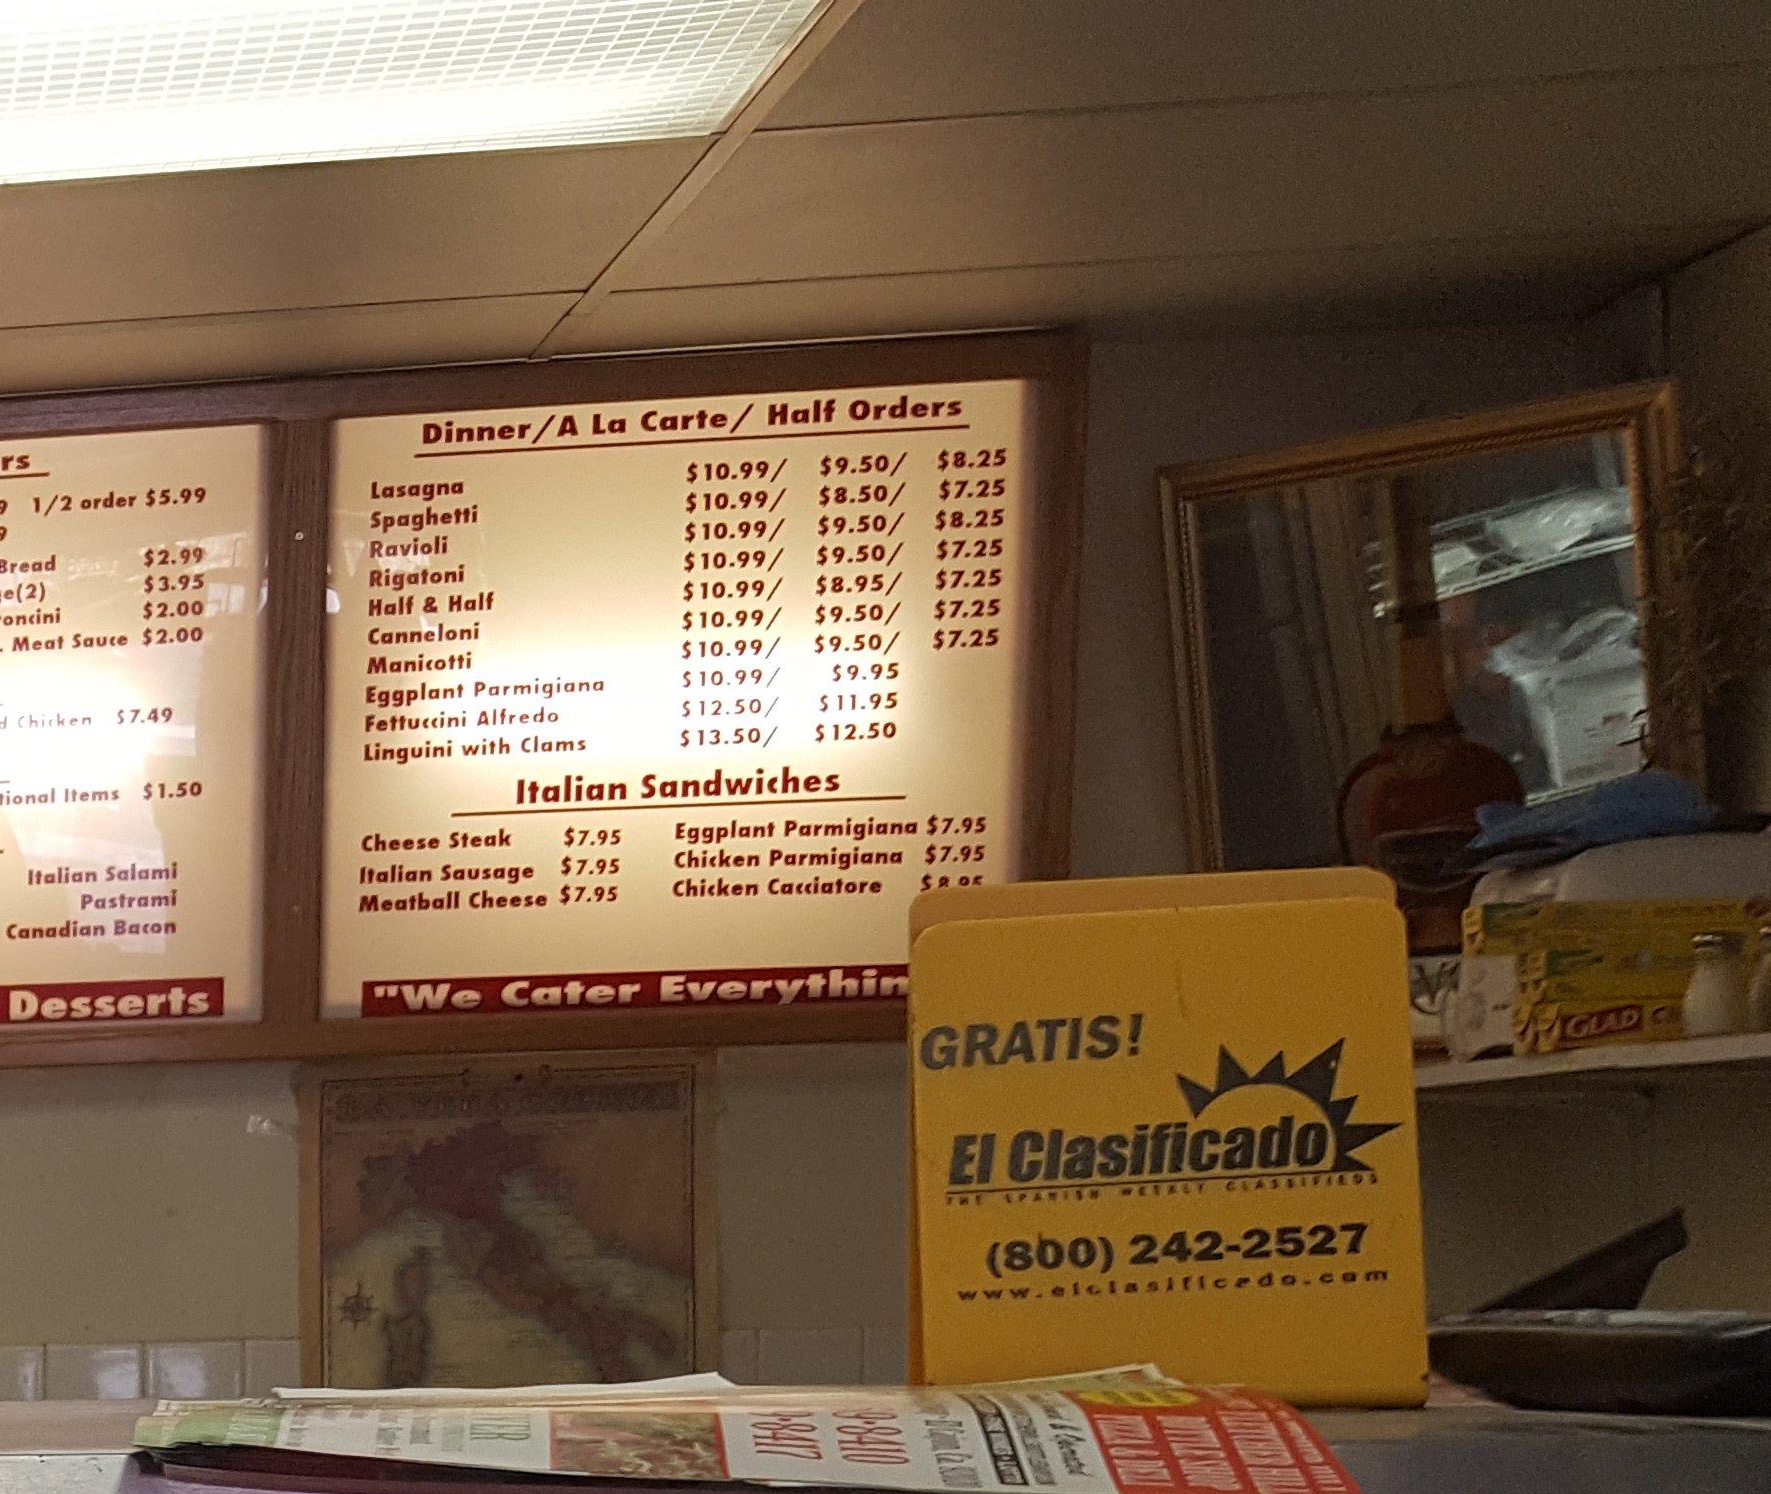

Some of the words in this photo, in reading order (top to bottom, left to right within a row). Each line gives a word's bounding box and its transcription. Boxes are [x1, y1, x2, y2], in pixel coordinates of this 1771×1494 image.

[423, 415, 578, 444] Dinner/A
[593, 414, 626, 435] La
[641, 403, 754, 433] Carte/
[768, 399, 836, 425] Half
[849, 395, 961, 420] Orders
[371, 482, 463, 501] Lasagna
[687, 458, 788, 484] $10.99/
[820, 452, 907, 477] $9.50/
[938, 448, 1006, 472] $8.25
[33, 495, 72, 516] 1/2
[81, 491, 137, 510] order
[146, 487, 206, 507] $5.99
[516, 775, 627, 804] Italian
[641, 766, 840, 799] Sandwiches
[9, 985, 210, 1020] Desserts
[501, 981, 641, 1004] Cater
[660, 967, 909, 1007] Everythin
[920, 1013, 1144, 1070] GRATIS!
[1567, 1010, 1641, 1038] GLAD
[949, 1133, 996, 1184] El
[1008, 1115, 1329, 1183] Clasificado
[1007, 1190, 1099, 1204] SPANISH
[1122, 1183, 1204, 1198] WEEKLY
[1226, 1173, 1378, 1192] CLASSIFIEDS
[986, 1233, 1114, 1278] (800)
[1130, 1222, 1368, 1264] 242-2527
[958, 1269, 1389, 1301] www.elclasificado.com
